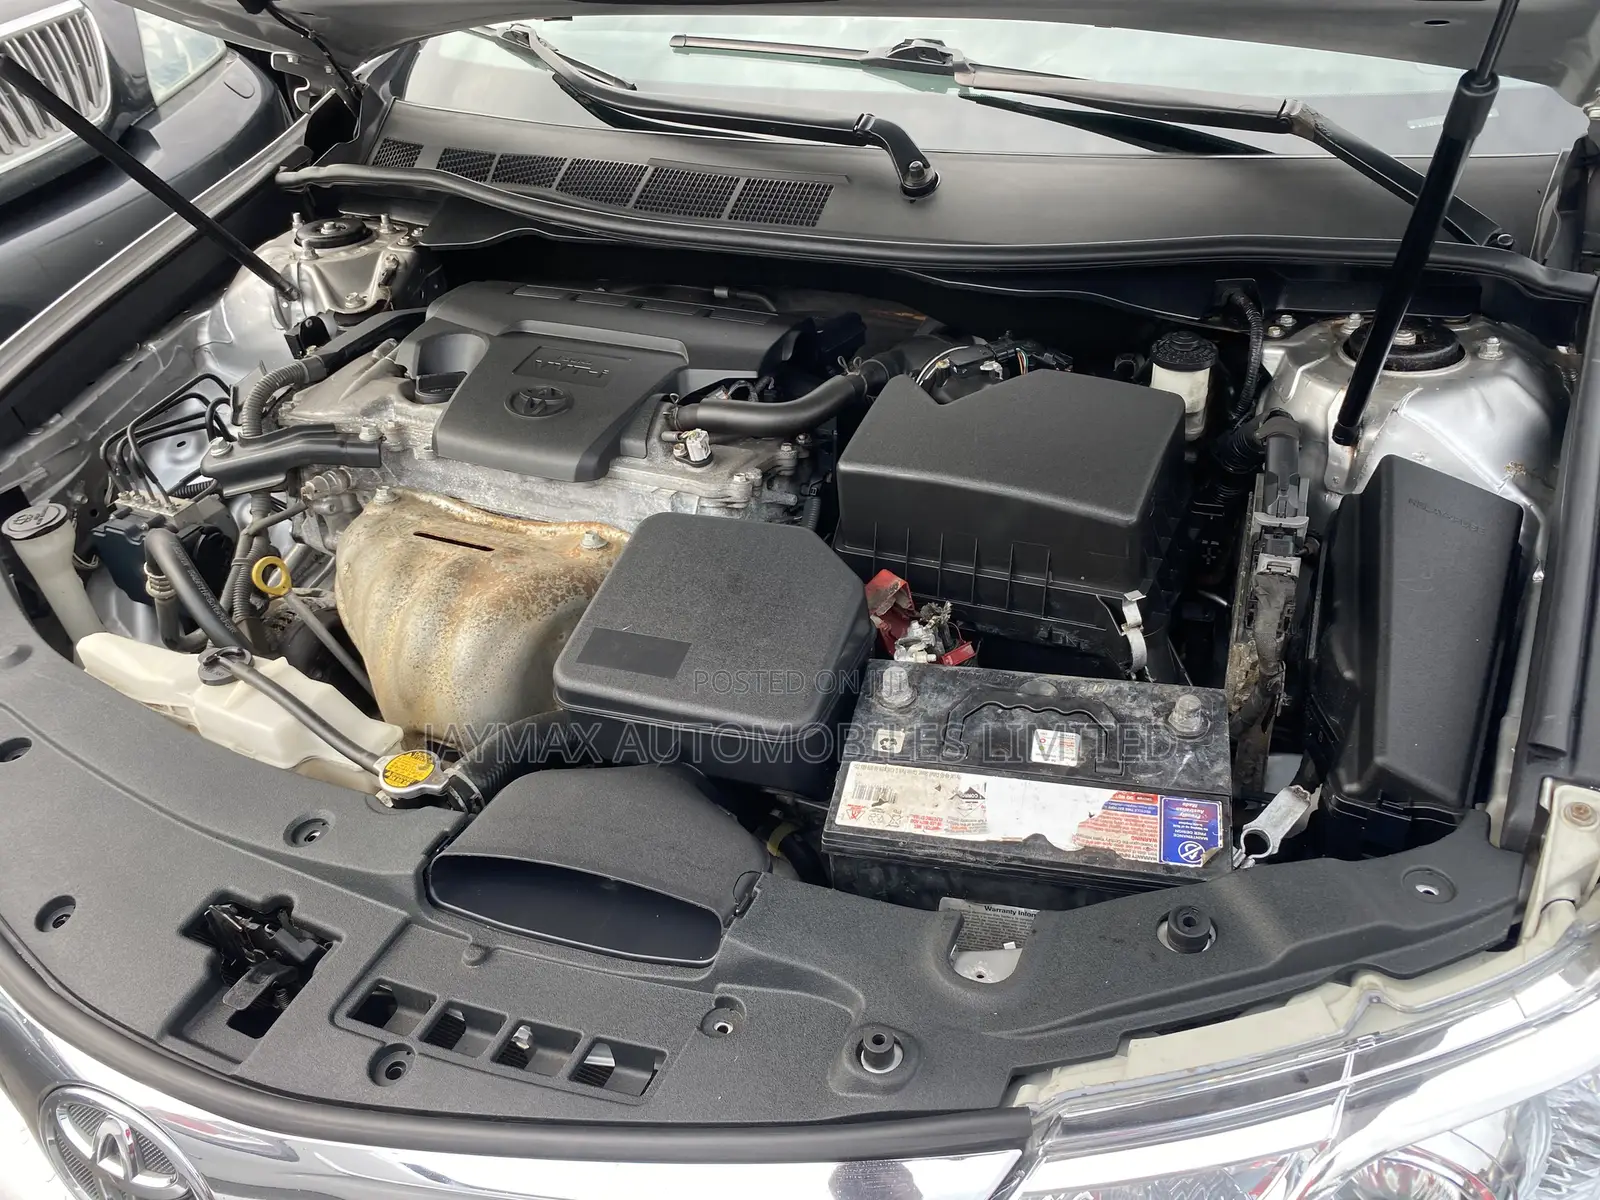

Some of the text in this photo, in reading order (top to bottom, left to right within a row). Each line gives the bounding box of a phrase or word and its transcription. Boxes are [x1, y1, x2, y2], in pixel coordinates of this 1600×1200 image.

[1130, 835, 1158, 843] WARNING
[1173, 833, 1209, 841] MAINTENANCE
[984, 905, 1016, 916] Warranty
